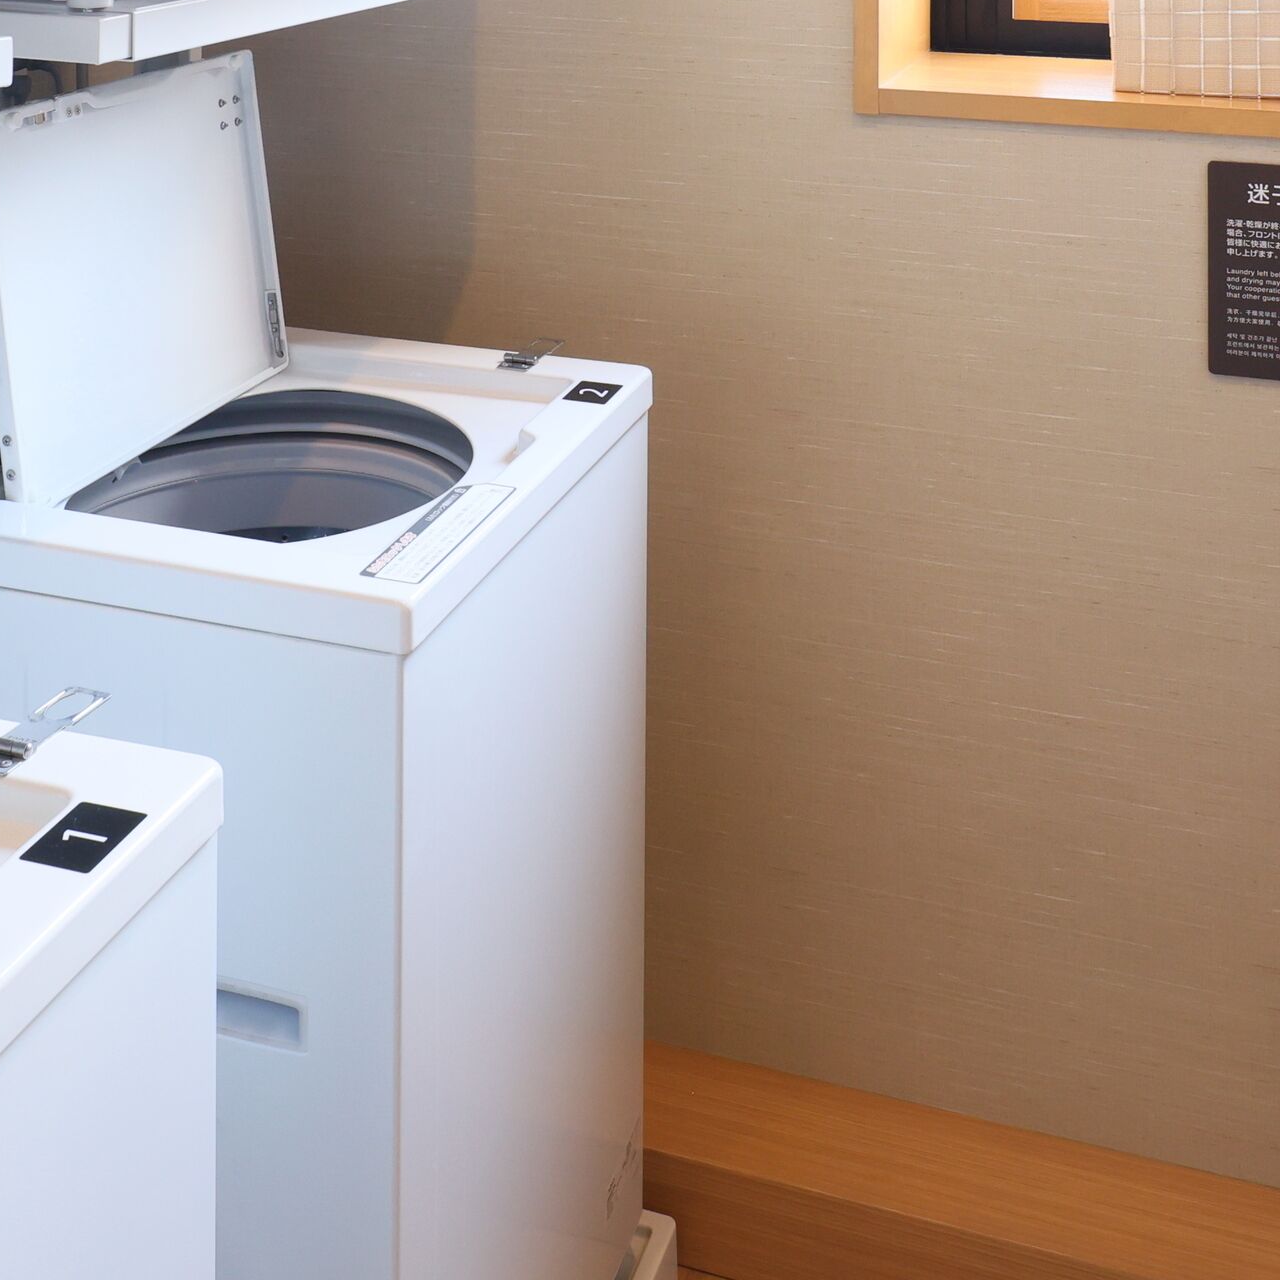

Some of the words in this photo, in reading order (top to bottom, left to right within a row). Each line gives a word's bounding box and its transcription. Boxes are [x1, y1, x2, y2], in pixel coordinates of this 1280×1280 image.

[1226, 248, 1279, 259] 申し上げます。
[1226, 268, 1255, 276] Laundry
[1241, 277, 1264, 285] drying
[577, 386, 610, 399] 2
[62, 829, 109, 844] 1
